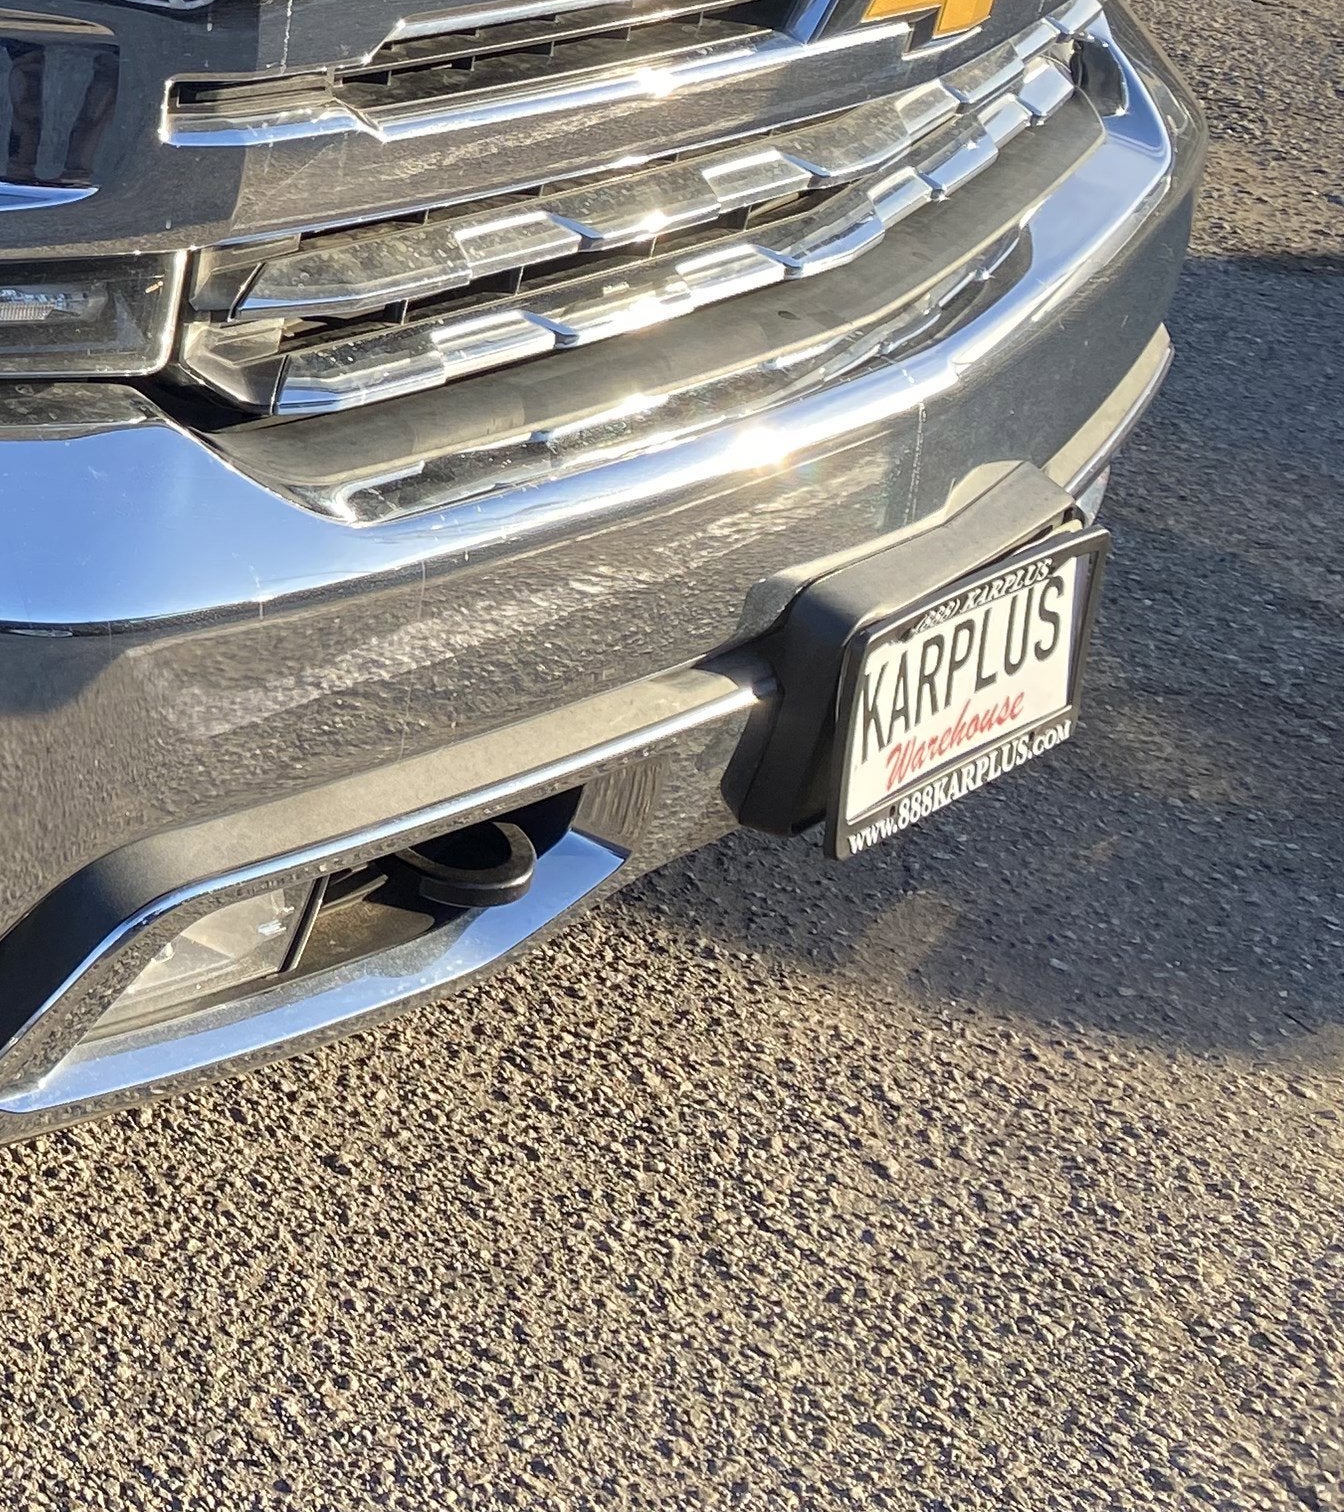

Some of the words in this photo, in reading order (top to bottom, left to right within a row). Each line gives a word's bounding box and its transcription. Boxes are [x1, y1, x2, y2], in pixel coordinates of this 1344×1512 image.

[965, 558, 1053, 613] KARPLUS
[859, 574, 1065, 765] KARPLUS
[885, 691, 1025, 791] Warehouse
